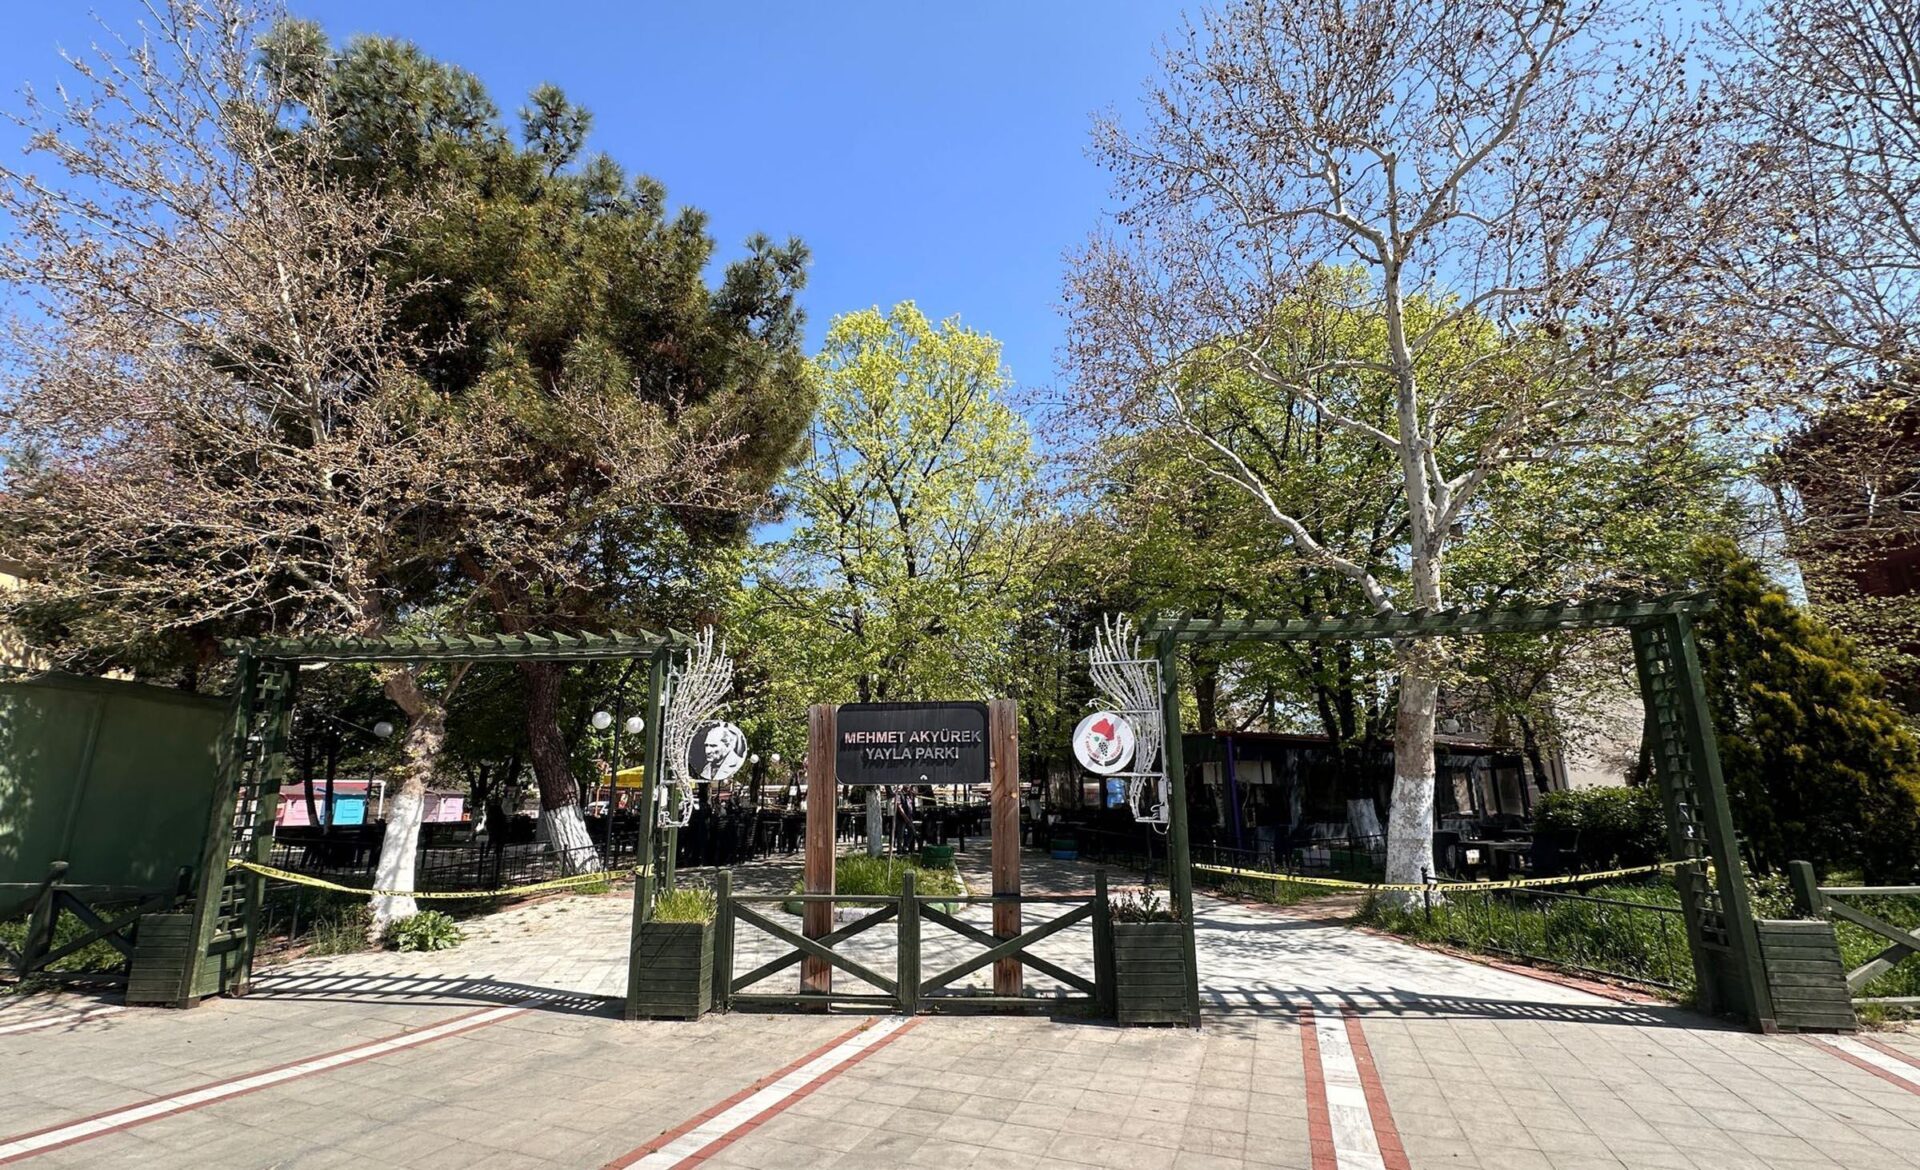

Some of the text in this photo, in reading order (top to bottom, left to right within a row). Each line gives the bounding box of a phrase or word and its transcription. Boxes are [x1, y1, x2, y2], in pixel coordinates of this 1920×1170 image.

[844, 728, 982, 744] MEHMET AKYÜREK
[866, 747, 959, 760] YAYLA PARKI
